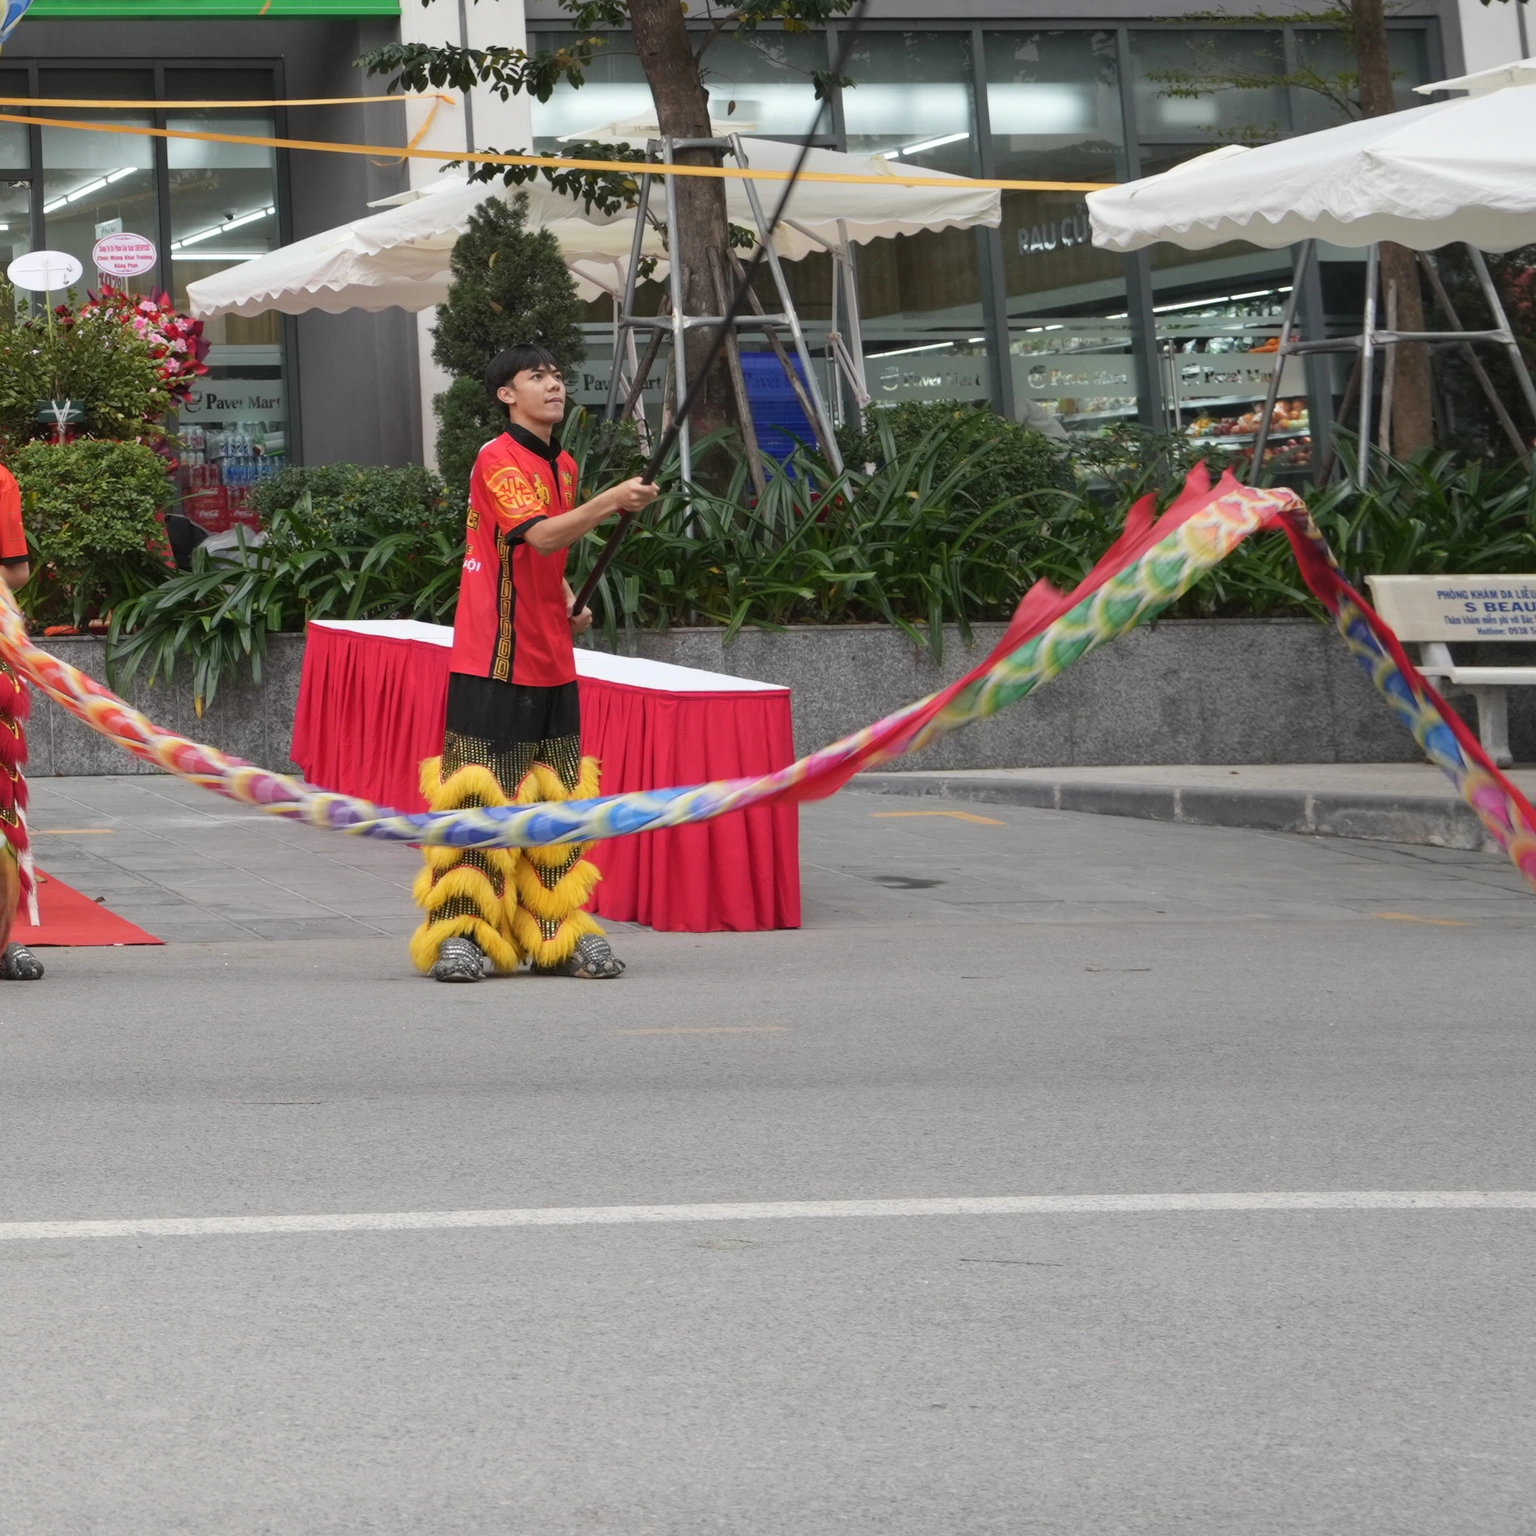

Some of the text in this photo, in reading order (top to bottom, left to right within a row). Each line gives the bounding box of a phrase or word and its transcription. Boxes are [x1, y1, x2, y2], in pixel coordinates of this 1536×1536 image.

[1017, 221, 1056, 257] RAU
[1436, 588, 1469, 600] PHÒNG
[1470, 588, 1498, 600] KHÁM
[1499, 589, 1514, 599] DA
[1464, 602, 1477, 613] S
